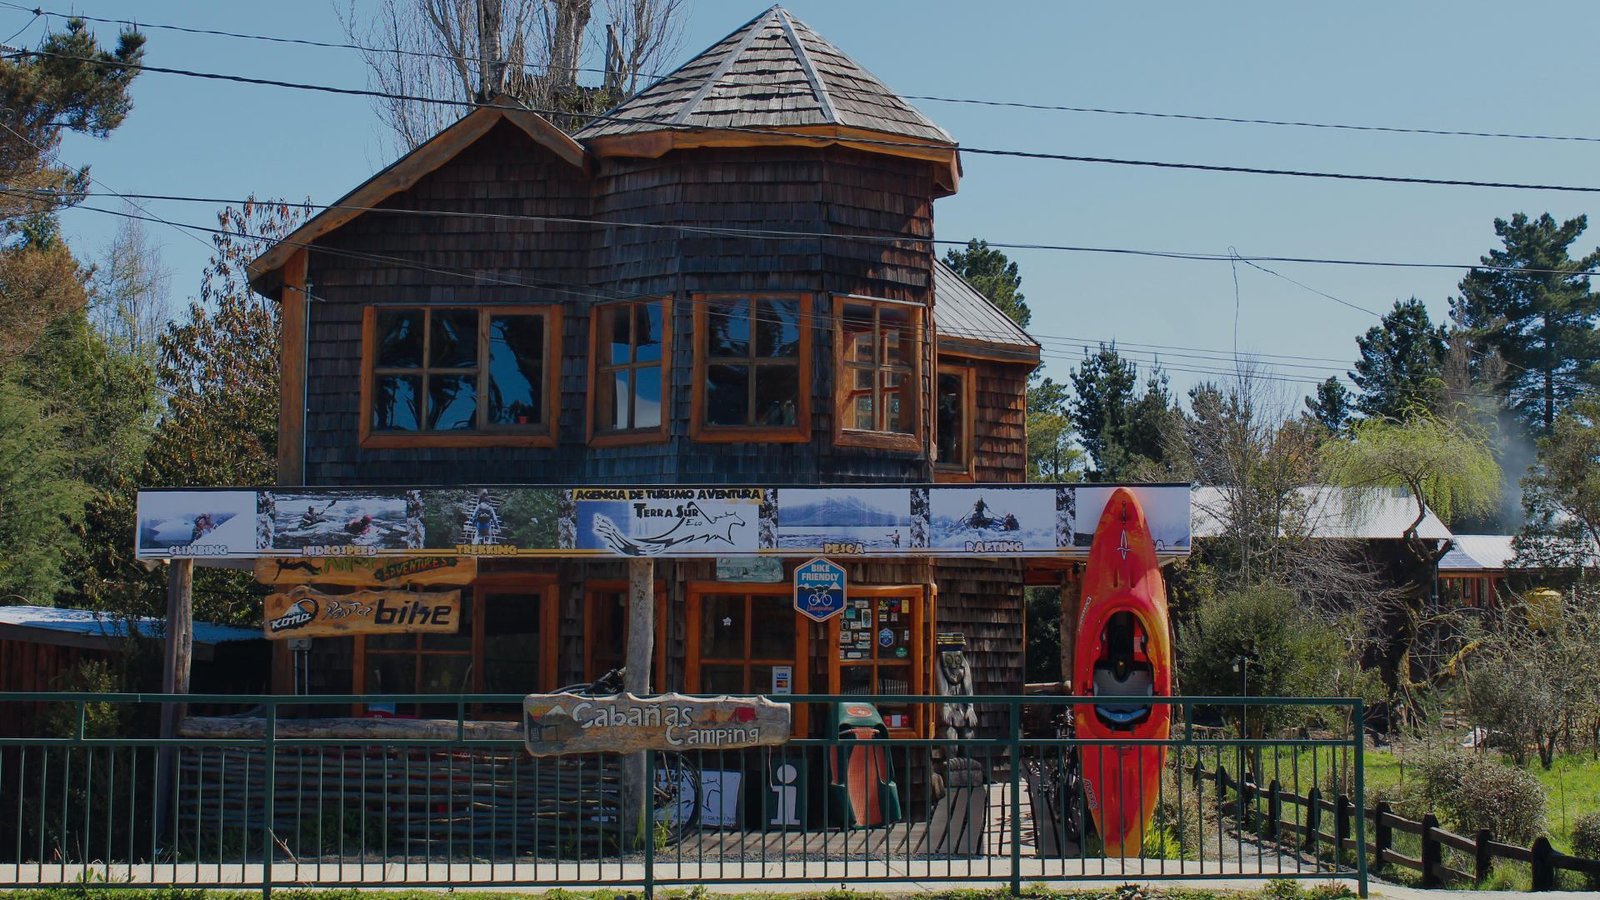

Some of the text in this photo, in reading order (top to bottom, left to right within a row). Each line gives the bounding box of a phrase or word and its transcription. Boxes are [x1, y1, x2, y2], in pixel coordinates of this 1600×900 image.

[576, 489, 761, 500] AGENCIA DE TURISMO AVENTURA
[168, 544, 229, 556] CLIMBING
[302, 545, 378, 557] HIDROSPEED
[456, 544, 518, 556] TREKKING
[823, 543, 866, 554] PESCA
[965, 541, 1024, 553] RAFTING
[811, 564, 831, 572] BIKE
[801, 572, 840, 581] FRIENDLY
[374, 599, 452, 625] bike
[572, 701, 694, 728] Cabañas
[665, 724, 761, 746] Camping
